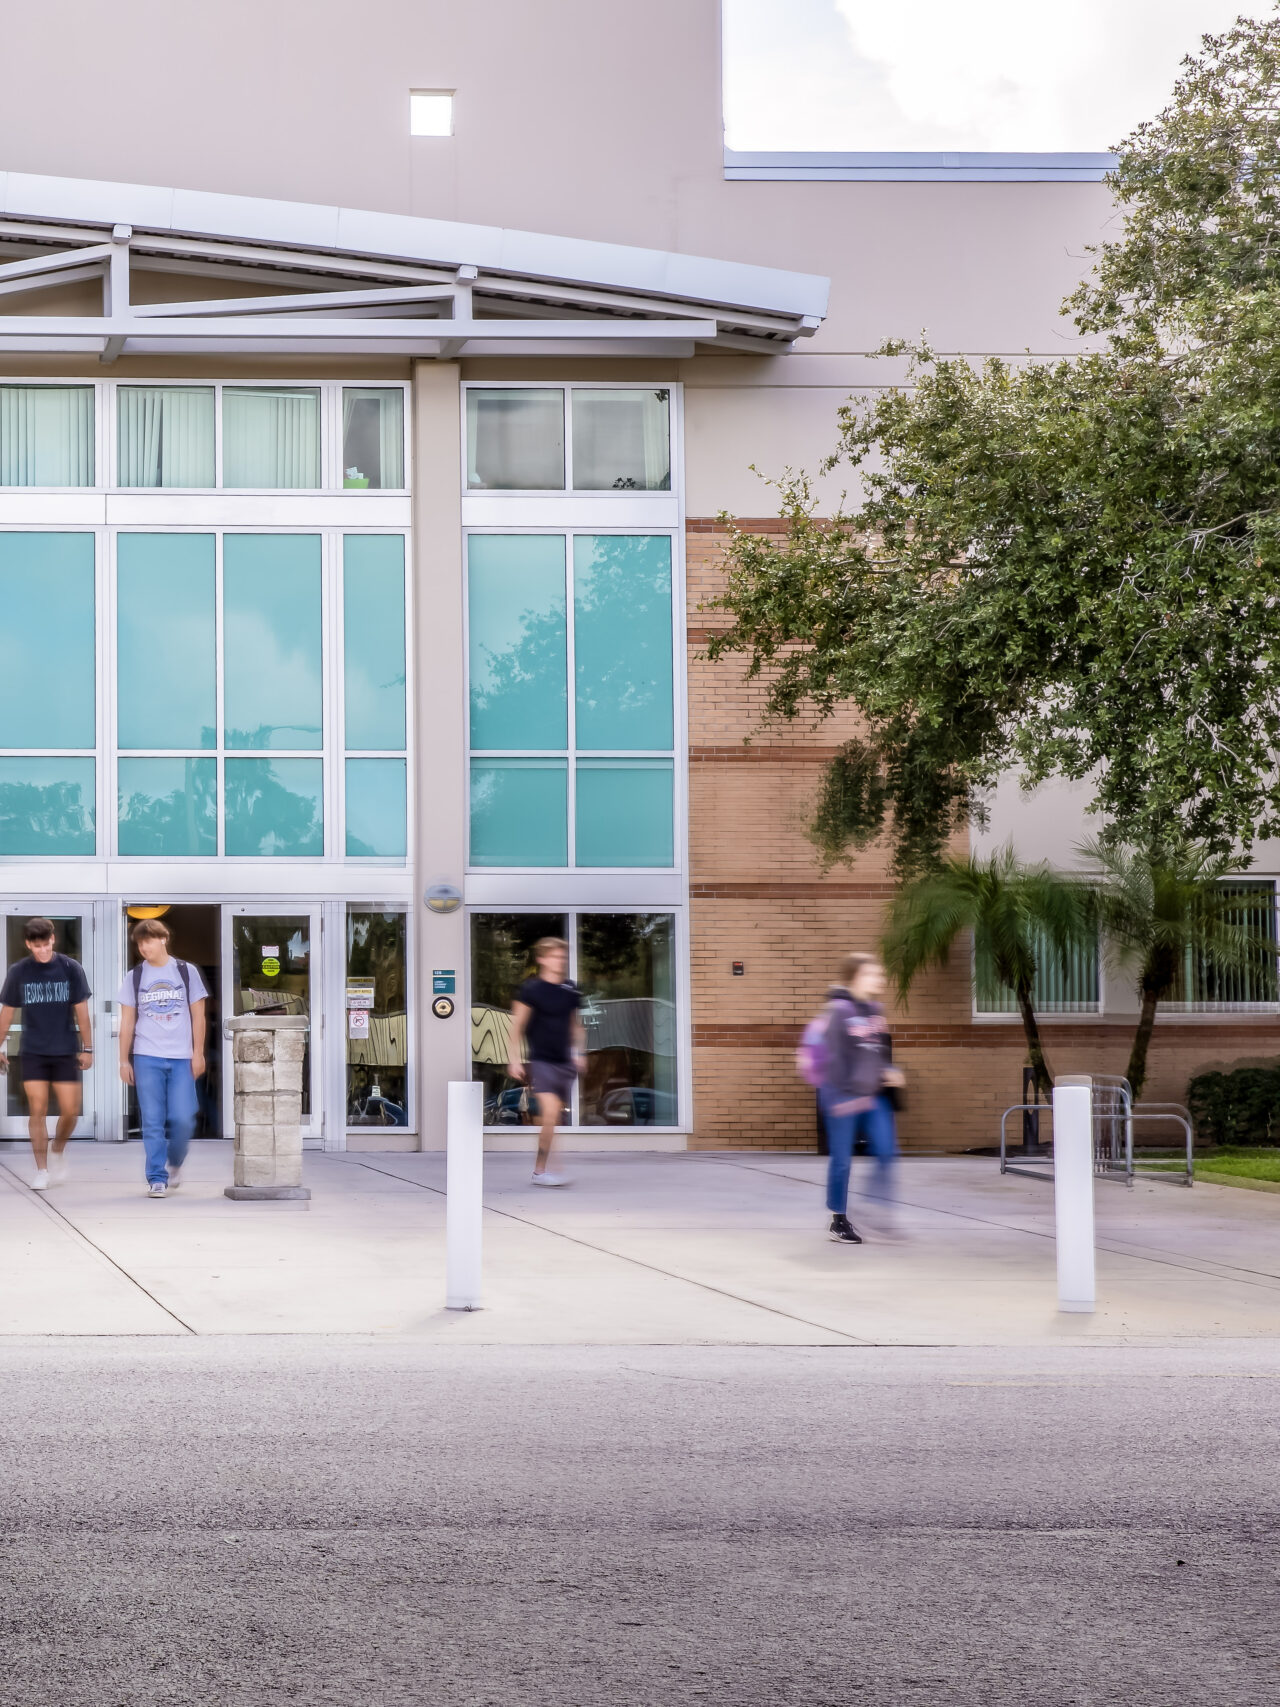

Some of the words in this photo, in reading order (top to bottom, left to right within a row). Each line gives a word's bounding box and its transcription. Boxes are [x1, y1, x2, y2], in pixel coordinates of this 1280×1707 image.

[24, 982, 43, 1004] JESUS
[45, 981, 53, 1002] IS
[54, 981, 69, 1002] KING
